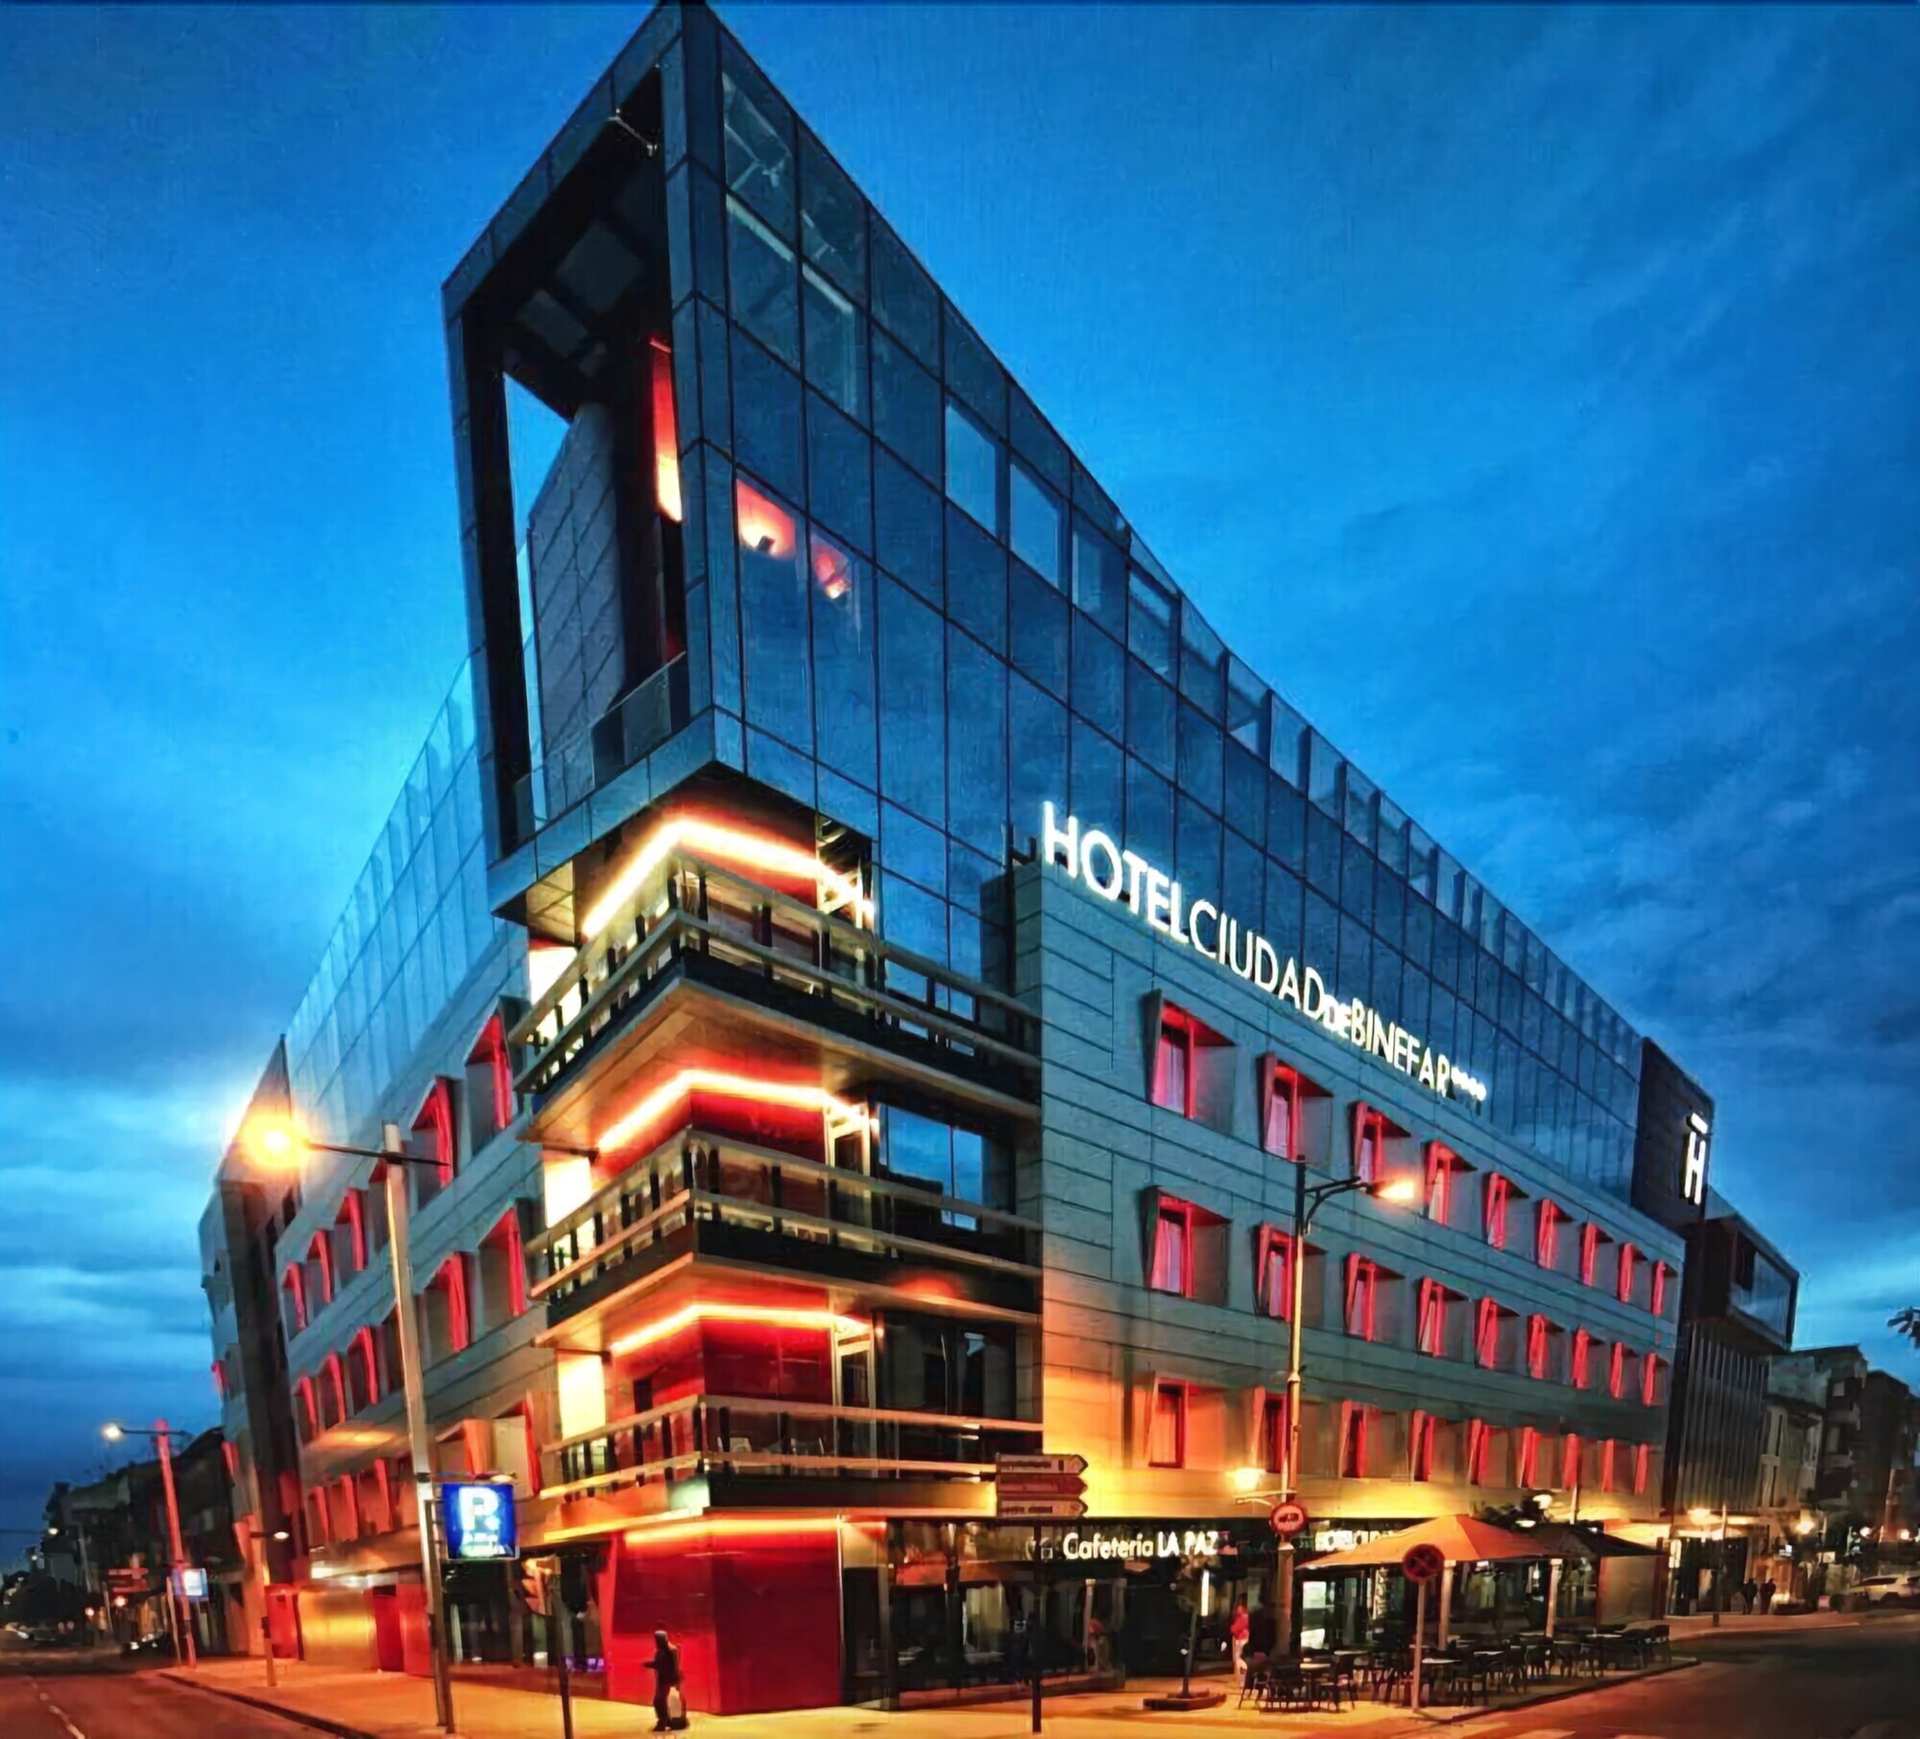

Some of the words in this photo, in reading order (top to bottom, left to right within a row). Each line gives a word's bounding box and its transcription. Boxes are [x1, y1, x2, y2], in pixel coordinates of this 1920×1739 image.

[1043, 800, 1189, 944] HOTEL
[1189, 899, 1325, 1018] CIUDAD
[1351, 997, 1450, 1098] BINEFAR
[1684, 1131, 1706, 1205] H
[1157, 1531, 1180, 1559] LA
[1184, 1530, 1219, 1556] PAZ
